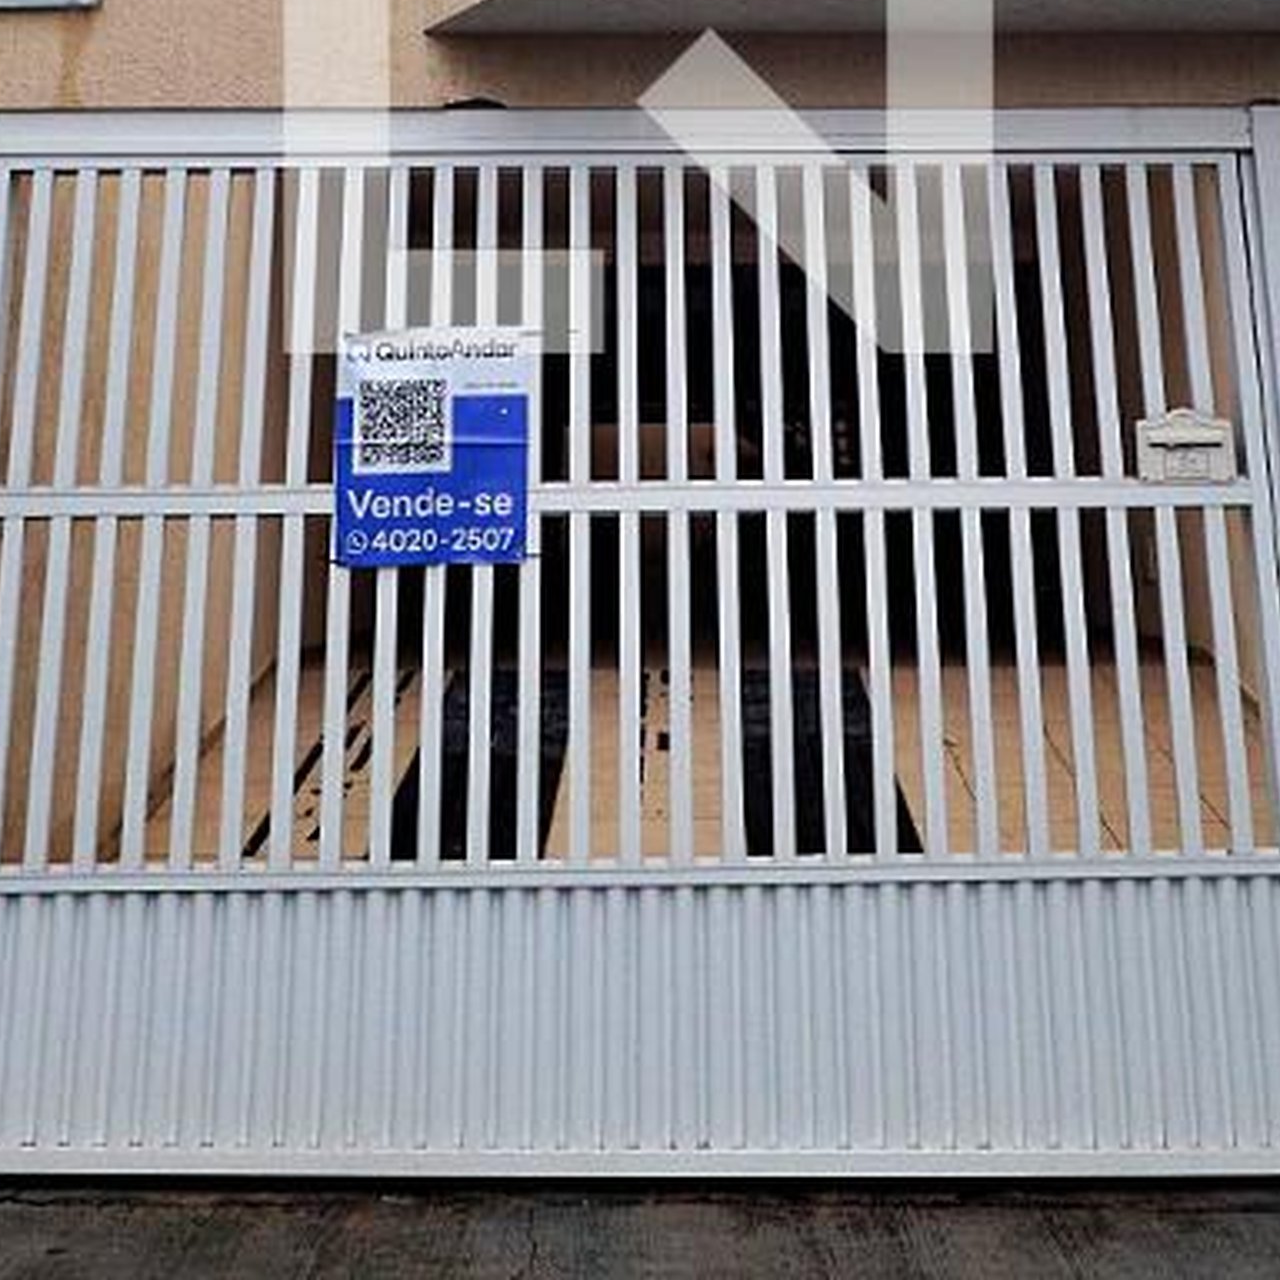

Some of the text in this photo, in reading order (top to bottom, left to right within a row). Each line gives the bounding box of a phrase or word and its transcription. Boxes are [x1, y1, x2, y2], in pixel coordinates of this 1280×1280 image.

[376, 339, 517, 362] QuintoAndar
[347, 488, 513, 518] Vende-se
[371, 529, 515, 552] 4020-2507
